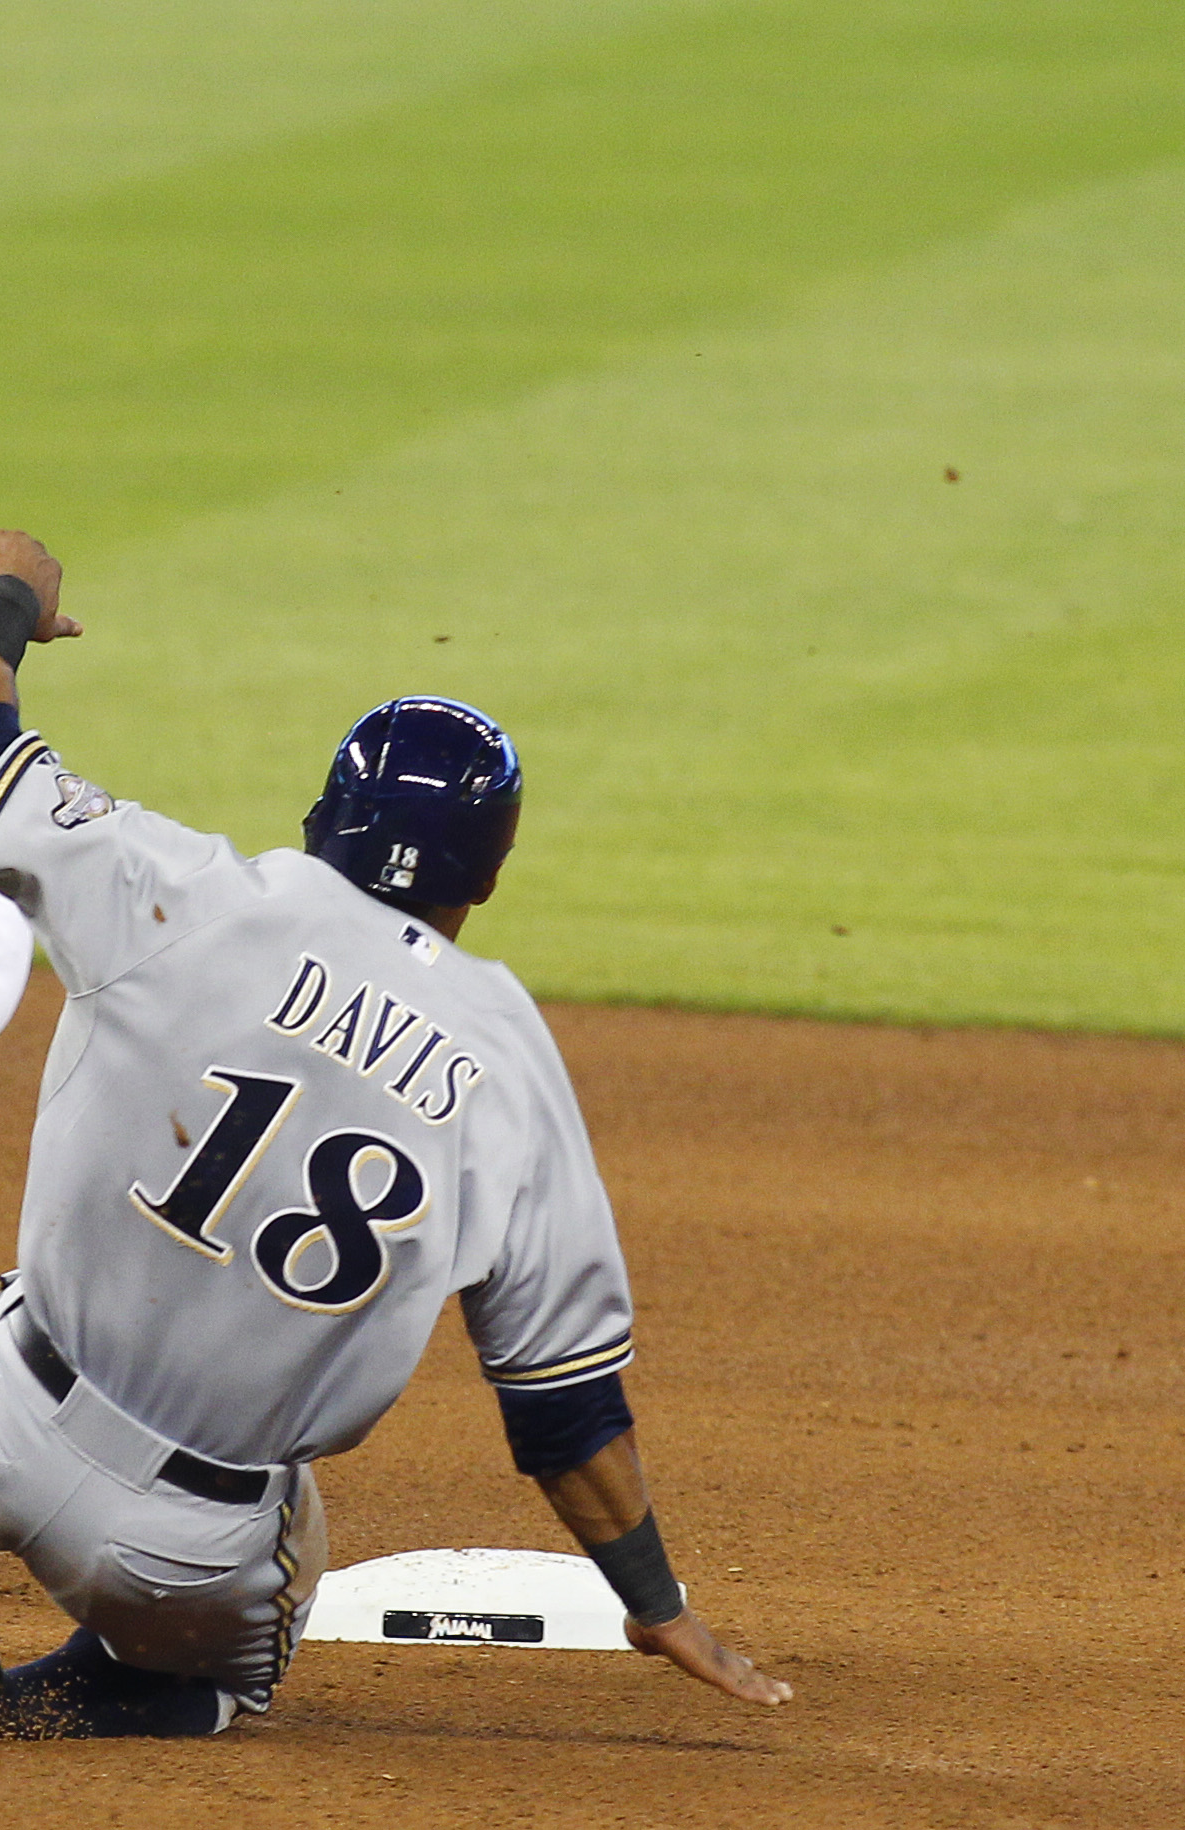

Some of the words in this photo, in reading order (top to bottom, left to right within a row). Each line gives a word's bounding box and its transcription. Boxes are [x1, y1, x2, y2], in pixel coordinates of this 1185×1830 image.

[388, 843, 419, 869] 18
[265, 951, 484, 1126] DAVIS
[128, 1064, 430, 1316] 18
